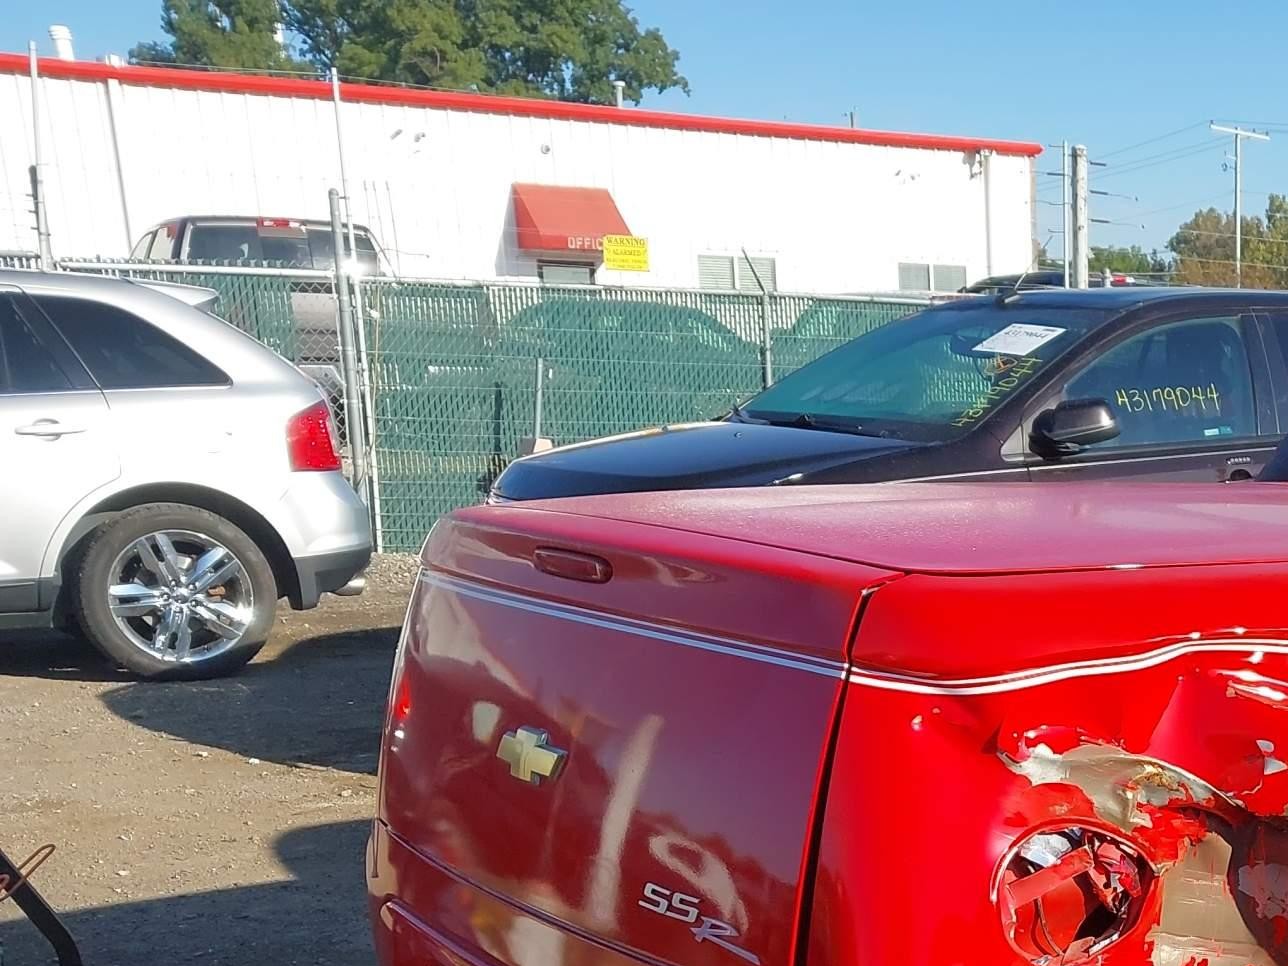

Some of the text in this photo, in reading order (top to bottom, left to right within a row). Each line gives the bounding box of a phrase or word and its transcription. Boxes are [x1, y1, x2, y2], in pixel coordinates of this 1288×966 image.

[567, 236, 604, 250] OFFIC
[606, 237, 645, 247] WARNING
[1116, 383, 1220, 413] 43179044
[638, 882, 761, 966] SSR
